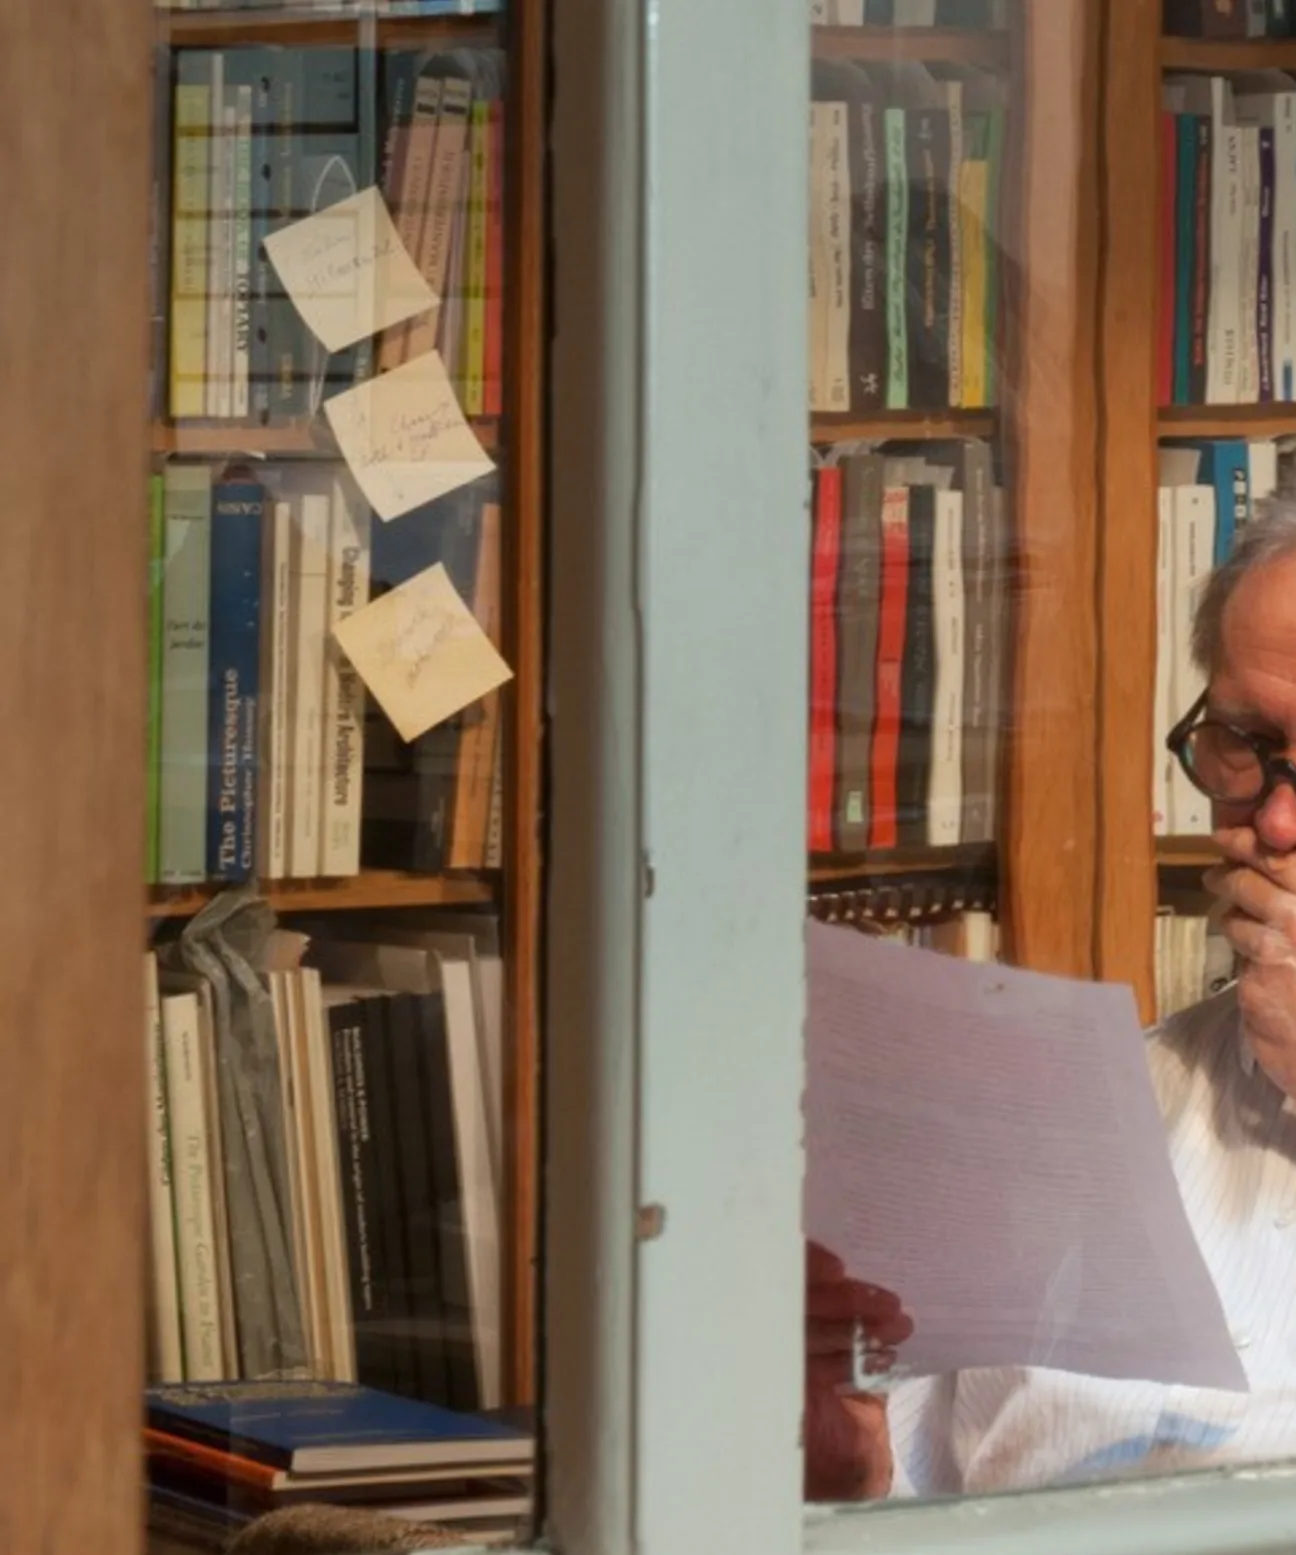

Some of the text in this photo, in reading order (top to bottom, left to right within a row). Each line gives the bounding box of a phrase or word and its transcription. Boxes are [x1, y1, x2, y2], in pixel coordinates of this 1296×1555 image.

[337, 546, 359, 607] Changing
[218, 667, 242, 871] The Picturesque
[334, 725, 354, 806] Architecture
